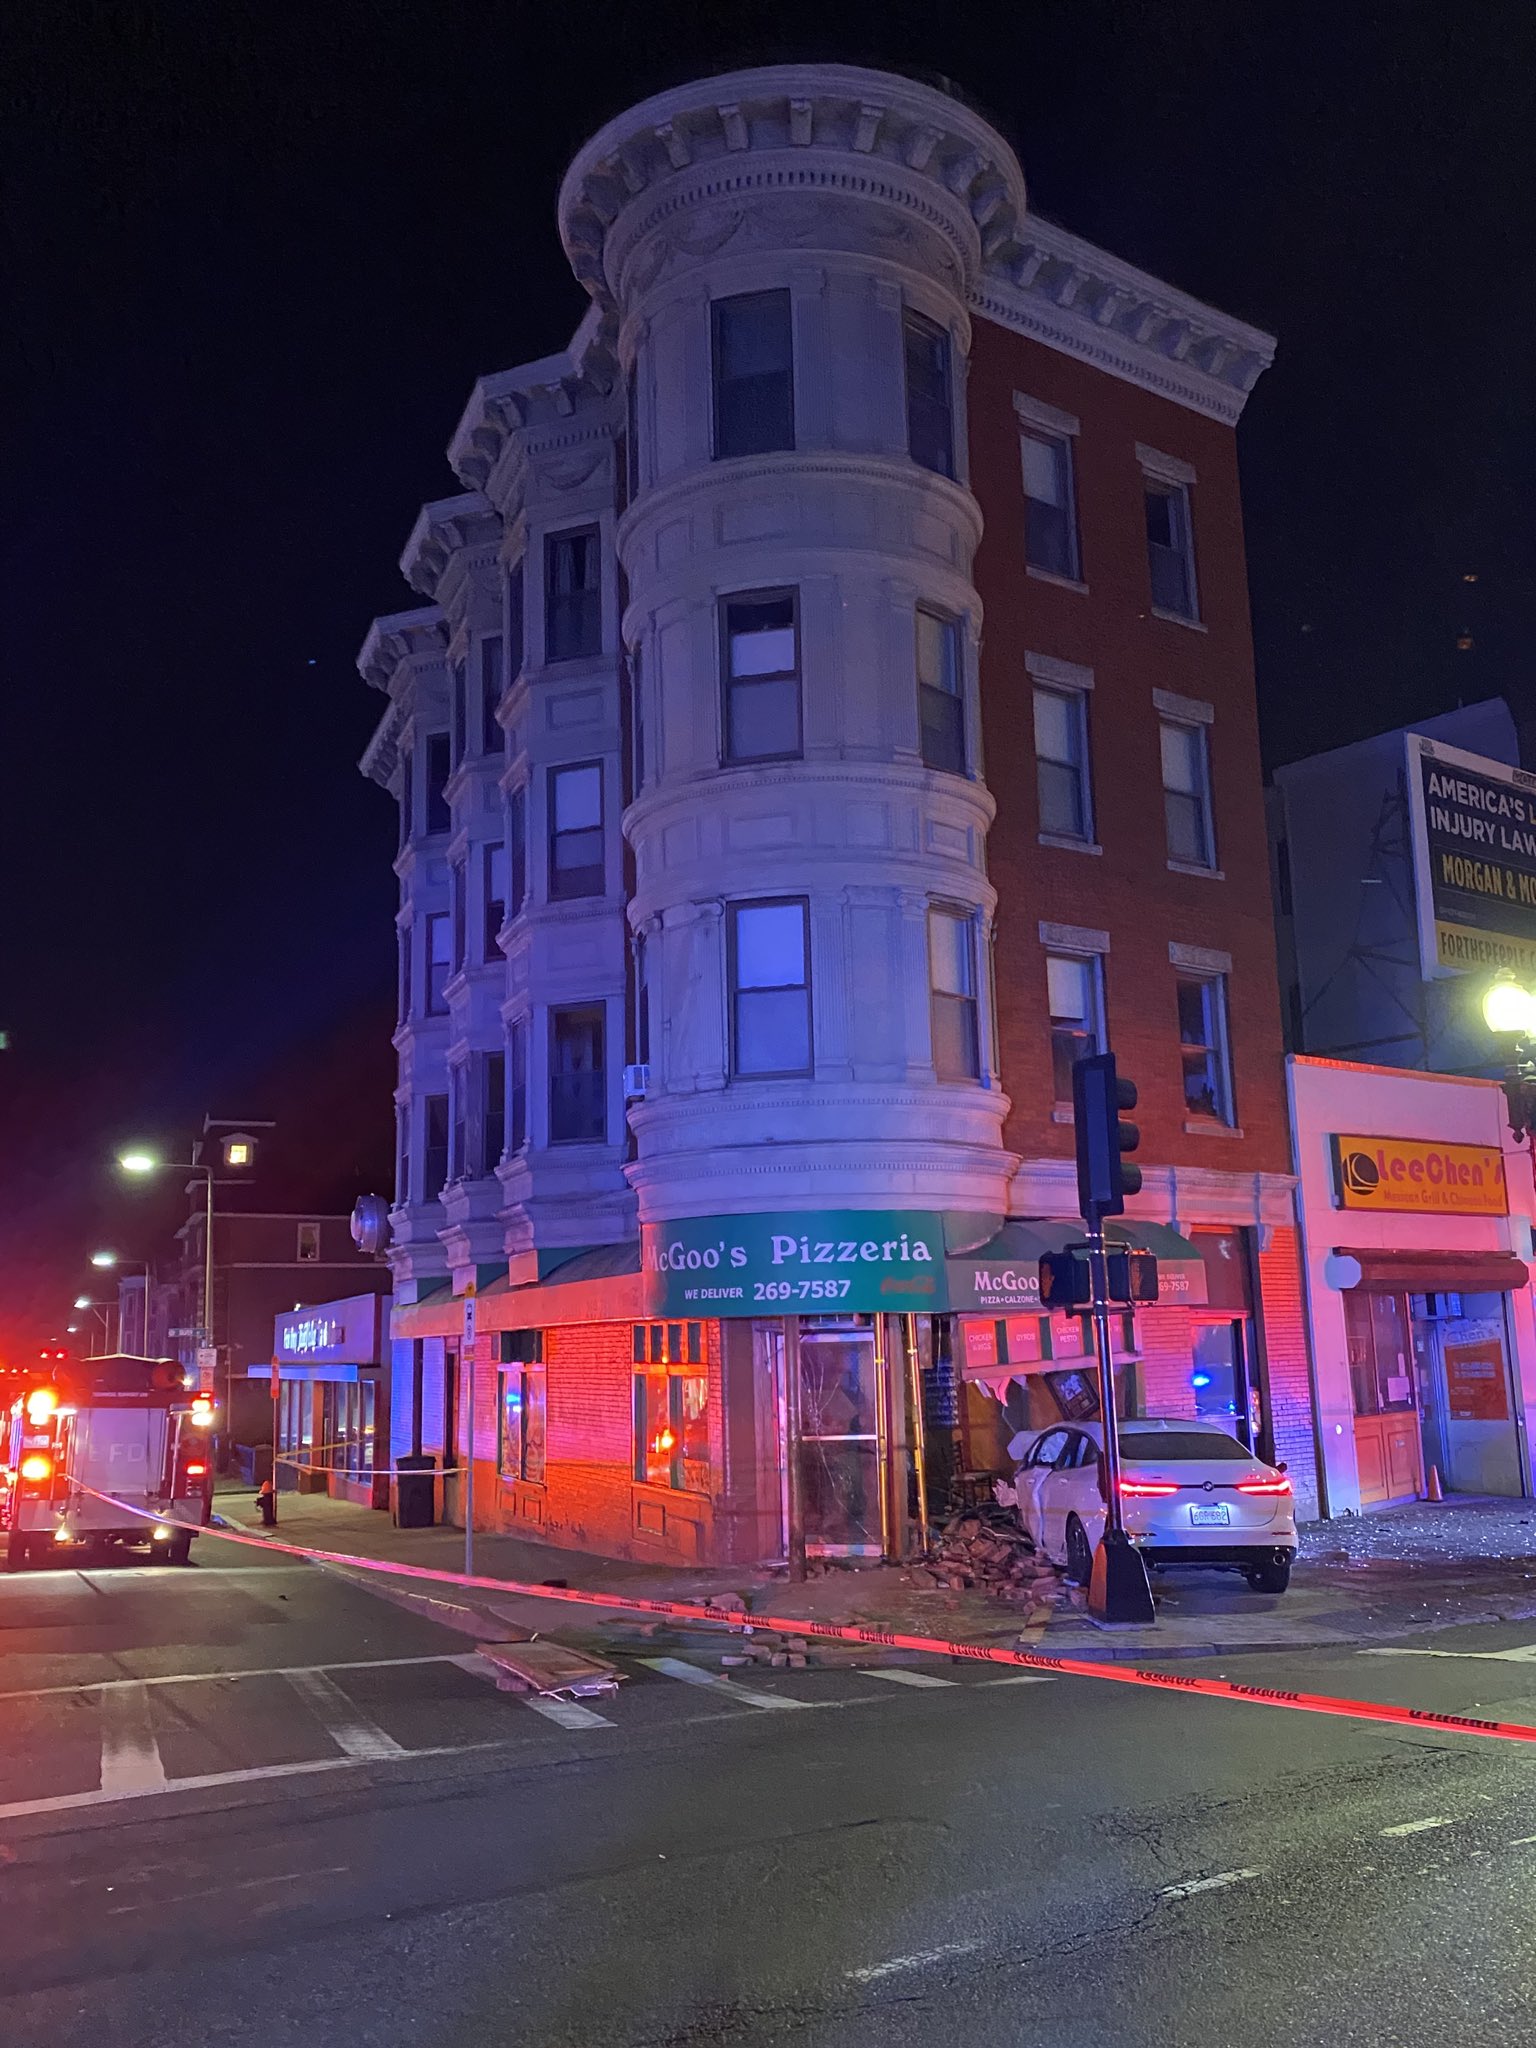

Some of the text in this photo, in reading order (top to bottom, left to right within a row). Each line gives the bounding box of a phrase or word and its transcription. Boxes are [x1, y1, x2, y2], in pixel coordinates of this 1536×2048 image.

[1428, 772, 1526, 822] AMERICA'S
[1430, 805, 1496, 844] INJURY
[1442, 854, 1503, 896] MORGAN
[1506, 870, 1517, 900] &
[1421, 1189, 1440, 1205] Grill
[646, 1233, 932, 1272] McGoo's Pizzeria
[684, 1279, 851, 1301] WE DELIVER 269-7587
[1015, 1333, 1036, 1342] GYROS
[1056, 1326, 1080, 1335] CHICKEN
[1060, 1334, 1078, 1343] PESTO
